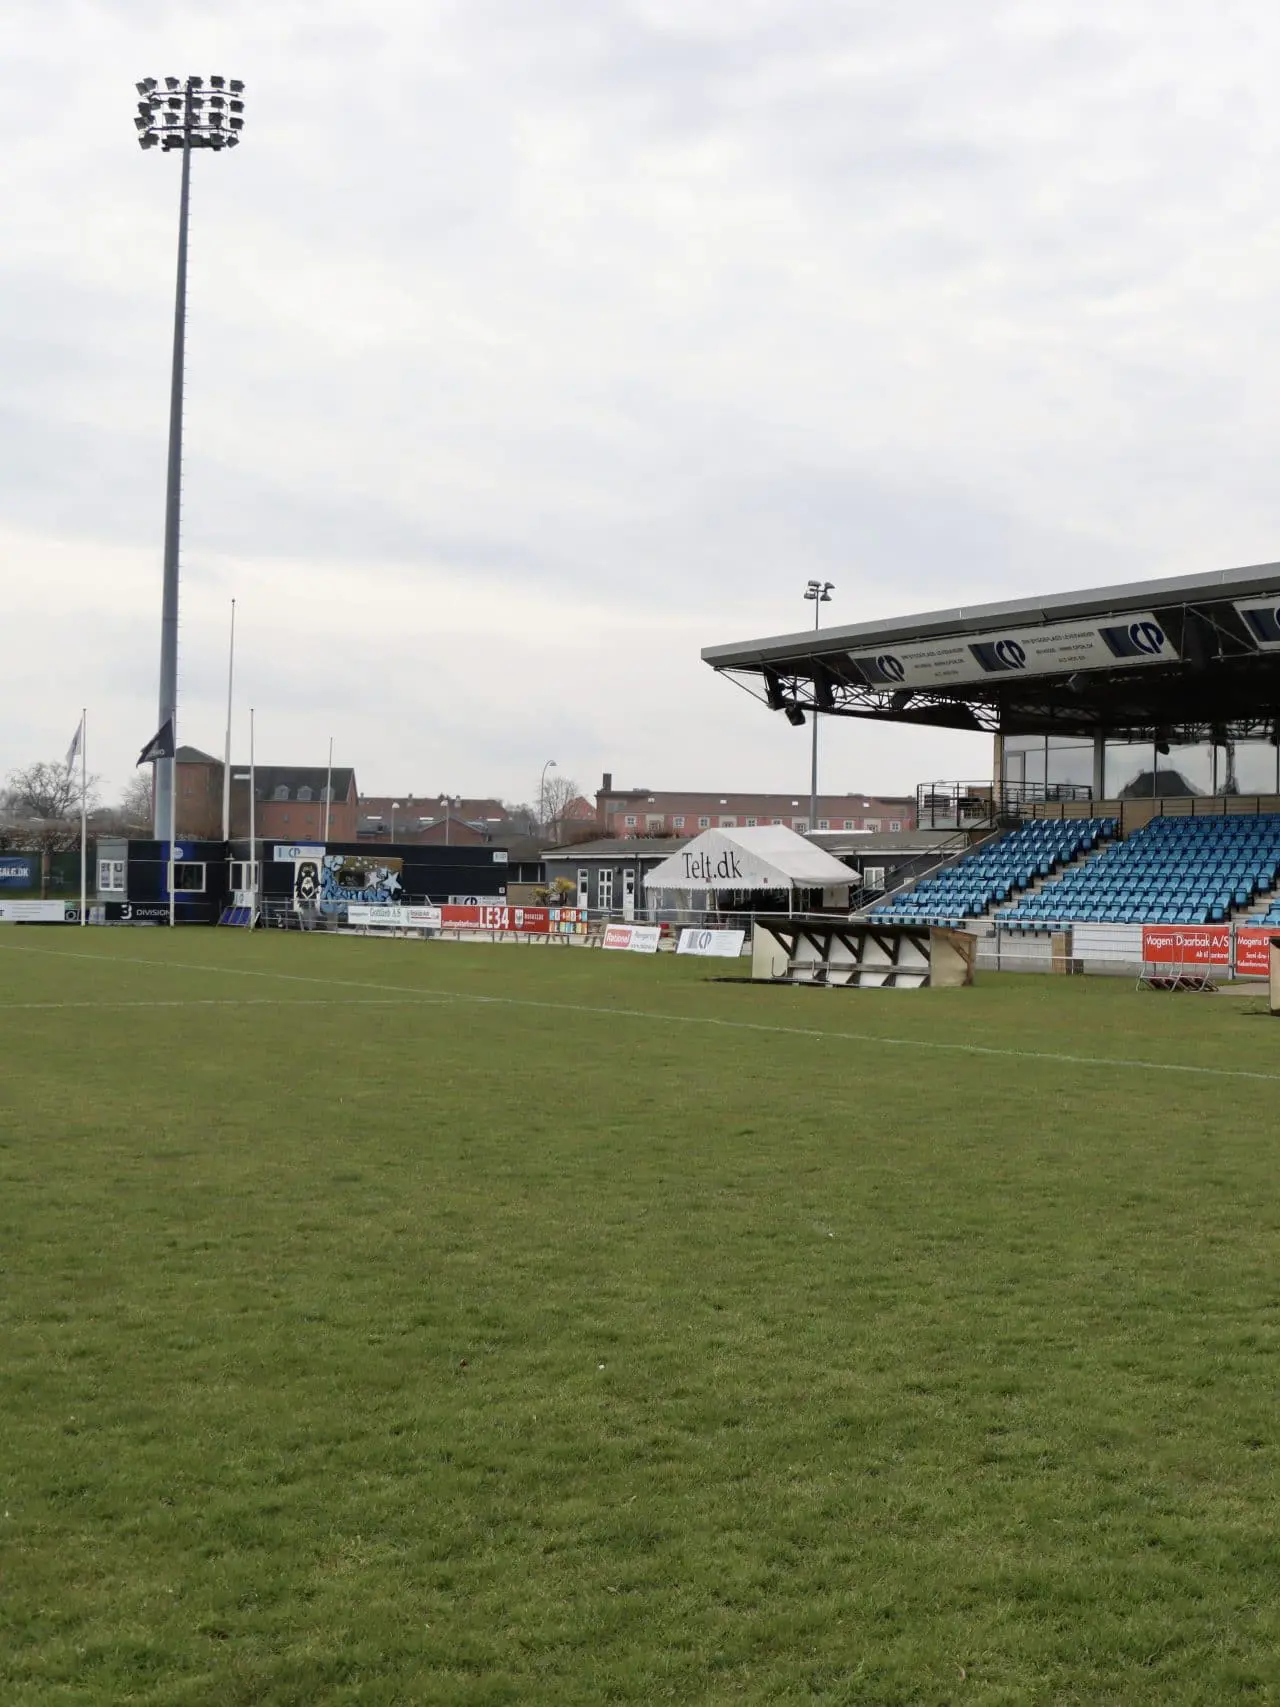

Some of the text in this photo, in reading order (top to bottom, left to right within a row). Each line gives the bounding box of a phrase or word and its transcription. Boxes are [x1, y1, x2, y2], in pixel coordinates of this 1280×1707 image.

[682, 851, 743, 879] Telt.dk
[480, 906, 510, 930] LE34
[1176, 935, 1210, 948] Daarbak
[1211, 934, 1229, 948] A/S
[1237, 936, 1262, 948] Mogens
